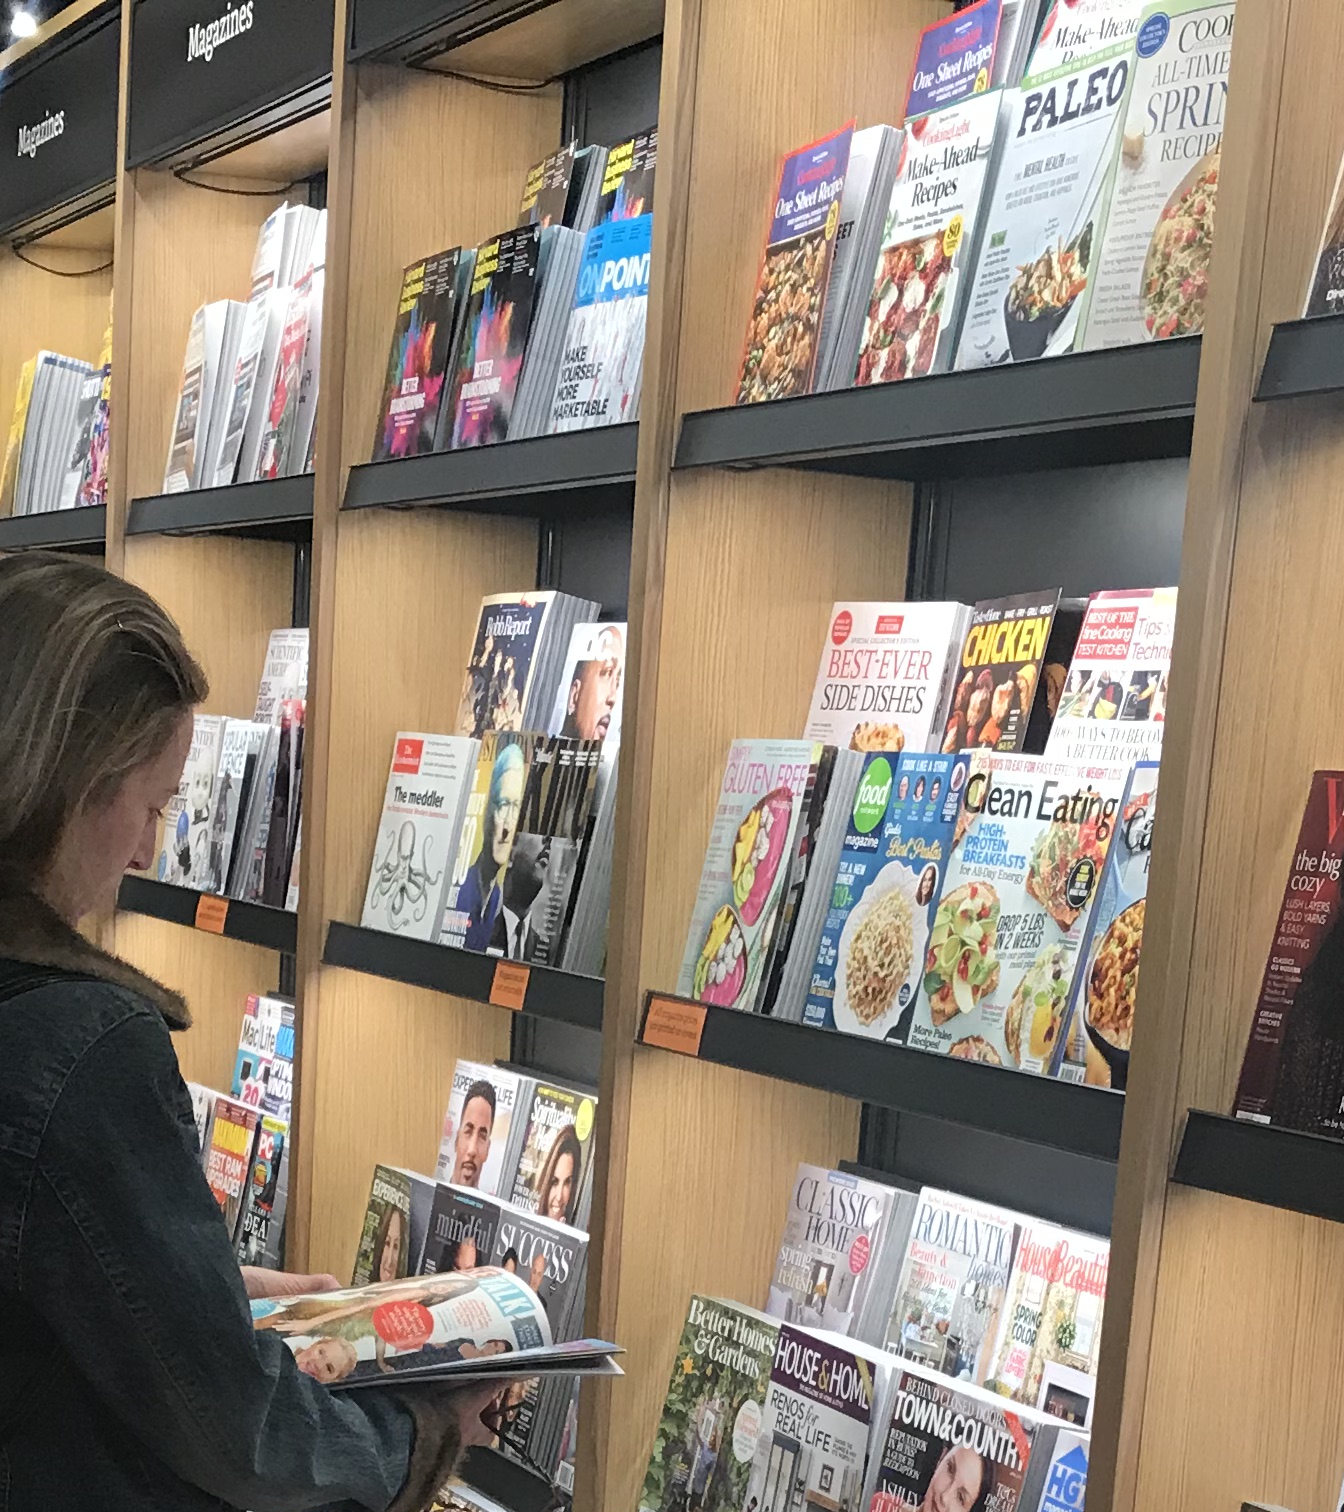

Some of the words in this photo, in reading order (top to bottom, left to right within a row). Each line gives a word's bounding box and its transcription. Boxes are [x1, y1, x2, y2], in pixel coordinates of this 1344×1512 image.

[187, 1, 254, 62] Magazines
[1151, 50, 1231, 88] ALL-TIME
[1016, 59, 1128, 139] PALEO
[17, 110, 65, 158] Magazines
[905, 137, 980, 184] Make-Ahead
[911, 176, 959, 207] Recipes
[564, 346, 588, 363] MAKE
[561, 361, 603, 382] YOURSELF
[557, 383, 579, 401] MORE
[962, 616, 1051, 668] CHICKEN
[826, 648, 933, 681] BEST-EVER
[820, 684, 858, 712] SIDE
[859, 685, 926, 715] DISHES
[724, 762, 774, 795] GLUTEN
[394, 785, 408, 805] The
[408, 789, 445, 809] meddler
[856, 781, 890, 813] food
[963, 772, 1033, 819] Clean
[1036, 780, 1119, 842] Eating
[844, 834, 879, 850] magazine
[964, 837, 1009, 852] PROTEIN
[977, 822, 1006, 838] HIGH-
[962, 849, 1026, 870] BREAKFASTS
[1295, 849, 1317, 875] the
[1318, 852, 1343, 882] big
[998, 868, 1026, 885] Energy
[1290, 873, 1325, 900] cozy
[997, 914, 1020, 931] DROP
[1028, 913, 1048, 931] LBS
[1014, 930, 1045, 949] WEEKS
[258, 1130, 274, 1159] PC
[435, 1208, 493, 1254] mindful
[913, 1202, 1013, 1269] ROMANTIC
[496, 1222, 574, 1284] SUCCESS
[688, 1299, 735, 1342] Better
[733, 1315, 778, 1358] Homes
[1013, 1303, 1043, 1332] SPRING
[1011, 1321, 1037, 1347] COLOR
[694, 1330, 710, 1355] &
[708, 1334, 762, 1379] Gardens
[770, 1388, 806, 1419] RENOS
[774, 1412, 804, 1442] REAL
[803, 1424, 833, 1453] LIFE
